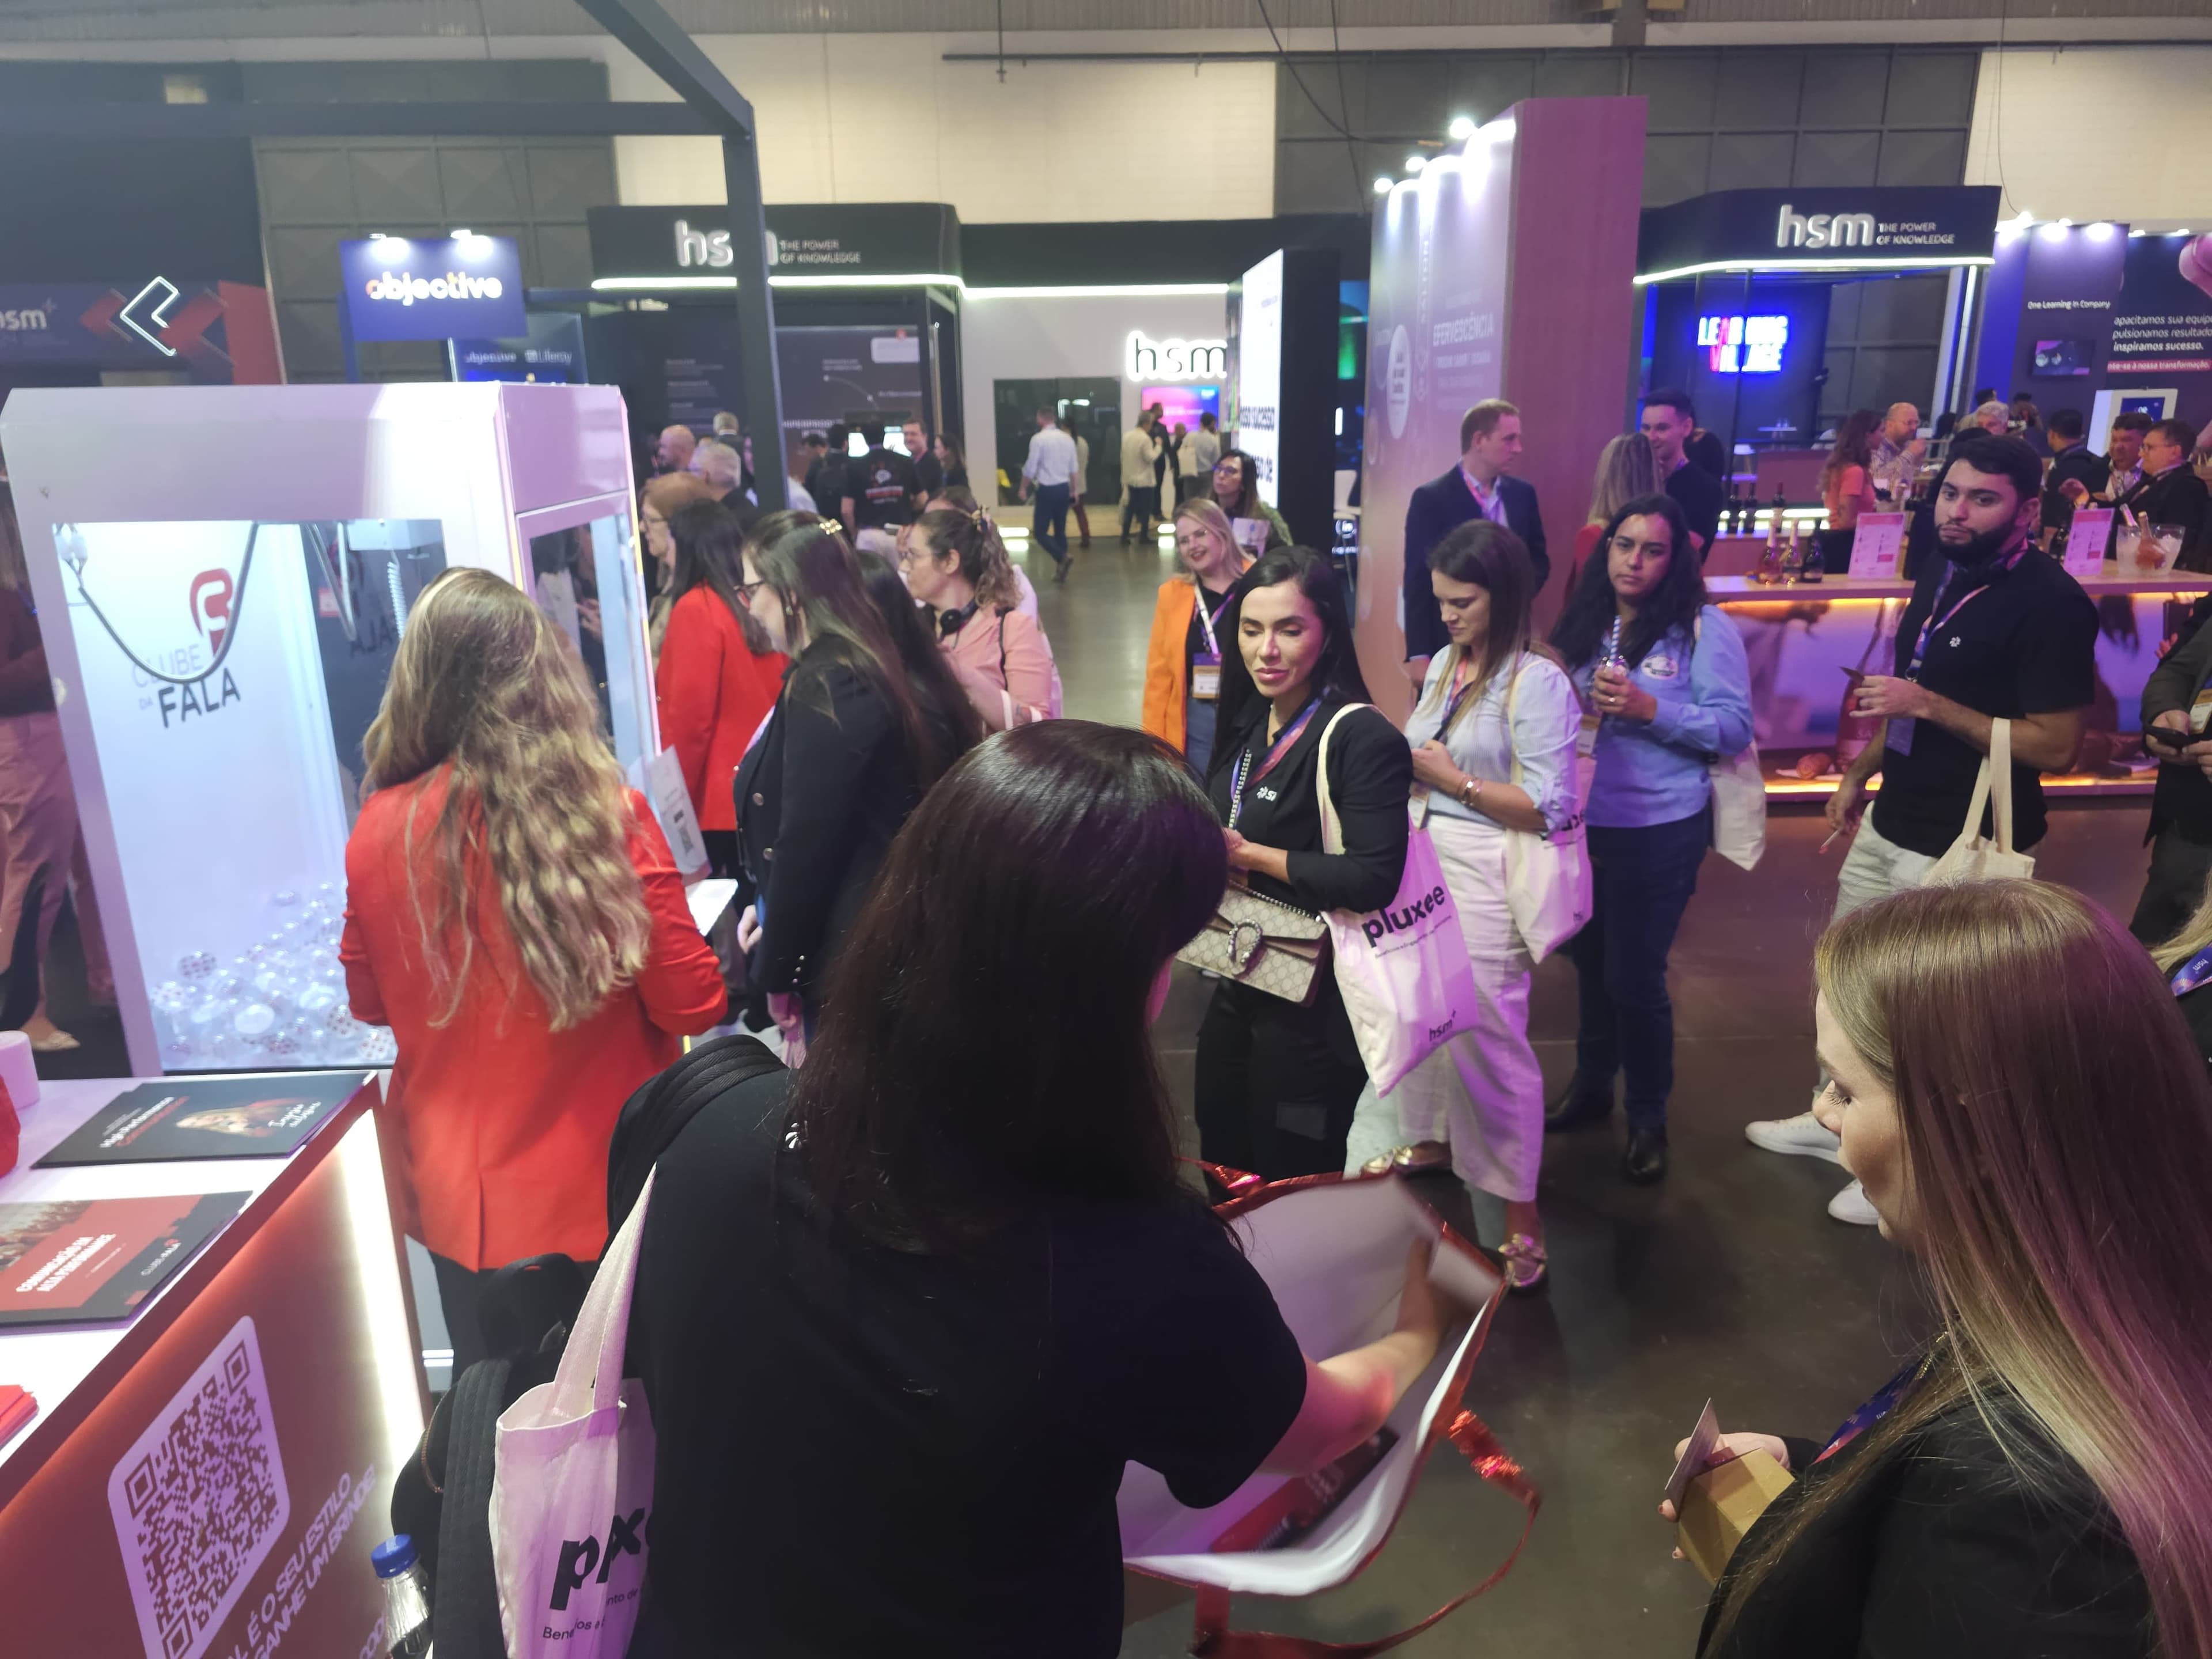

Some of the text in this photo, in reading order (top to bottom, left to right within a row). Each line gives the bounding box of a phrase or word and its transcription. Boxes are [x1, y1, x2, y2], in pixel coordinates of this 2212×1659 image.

[1777, 204, 1874, 248] hsm
[1878, 222, 1937, 233] THE POWER
[779, 239, 839, 251] THE POWER
[1876, 234, 1955, 245] OF KNOWLEDGE
[779, 252, 861, 264] OF KNOWLEDGE
[366, 271, 503, 306] objective
[2027, 301, 2042, 310] One
[2043, 299, 2072, 310] Learning
[2080, 300, 2111, 310] Company
[2168, 316, 2184, 325] sua
[1129, 333, 1227, 379] hsm
[2113, 341, 2164, 354] inspiramos
[158, 667, 241, 729] FALA
[1362, 886, 1445, 949] pluxee
[247, 1472, 351, 1648] É O SEU ESTILO
[305, 1542, 329, 1589] UM
